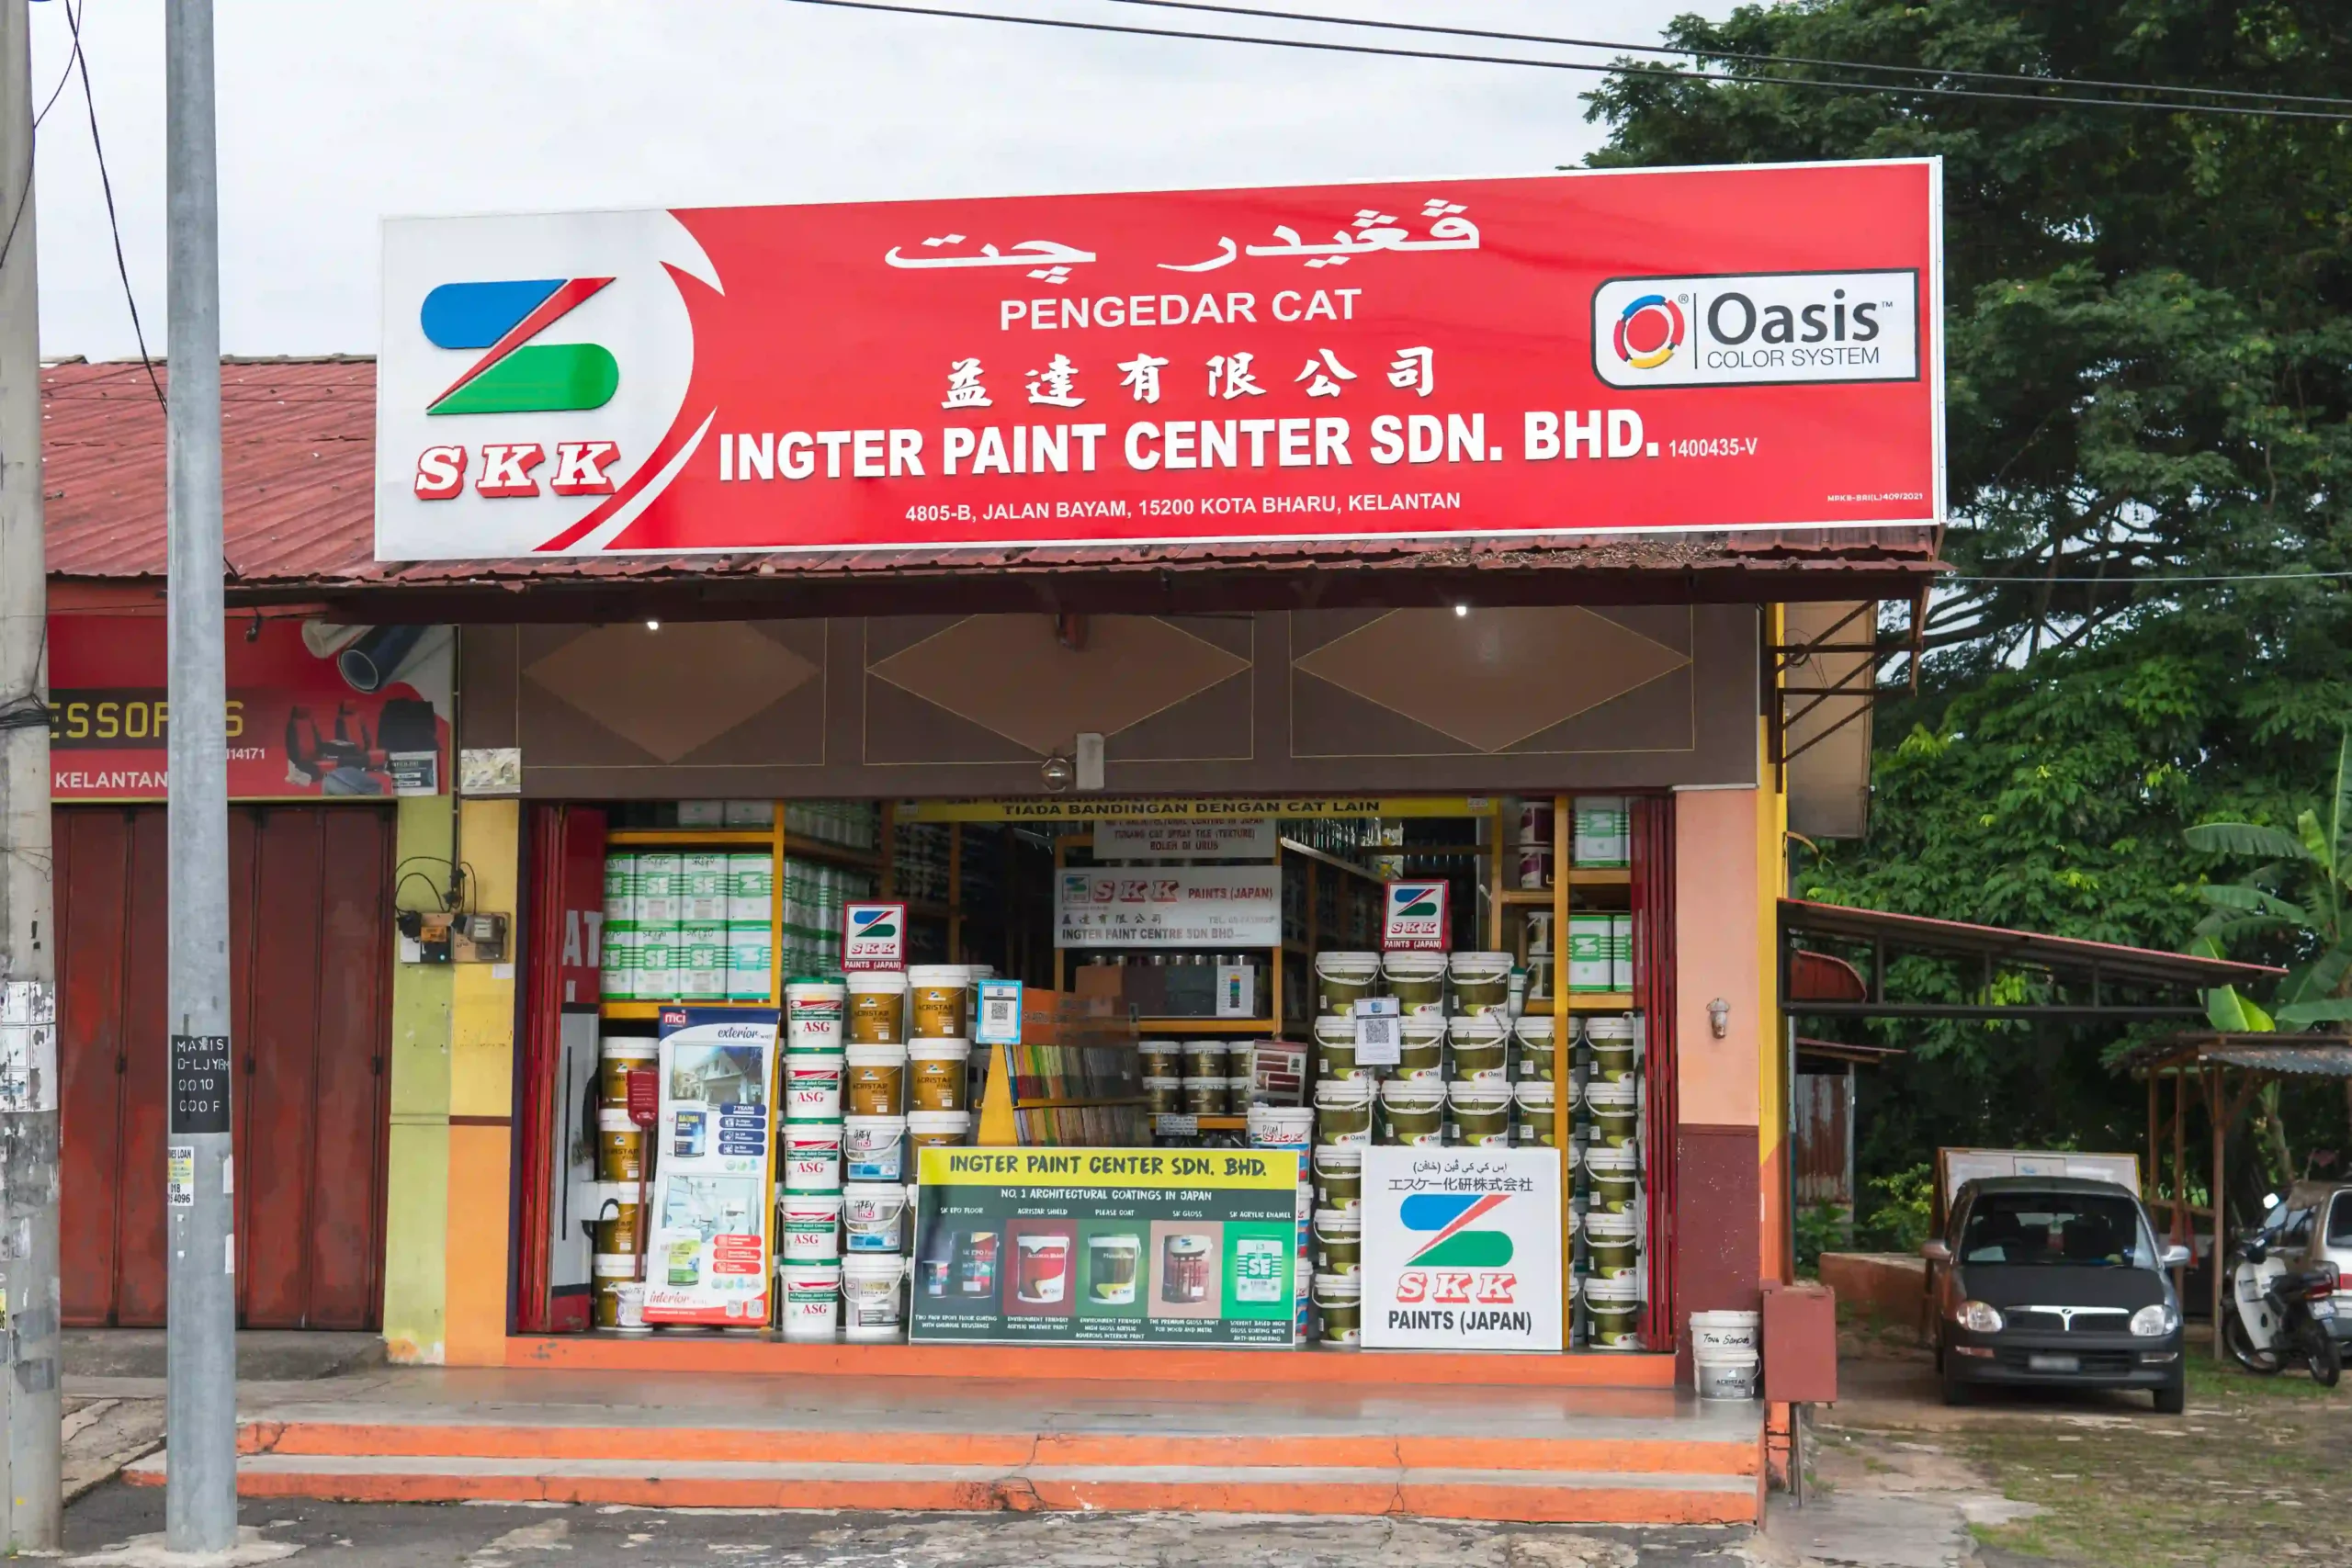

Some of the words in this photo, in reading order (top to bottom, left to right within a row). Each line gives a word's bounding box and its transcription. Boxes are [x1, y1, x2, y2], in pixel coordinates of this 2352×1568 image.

[1000, 293, 1256, 331] PENGEDAR
[1272, 288, 1363, 322] CAT
[1707, 288, 1881, 345] Oasis
[1707, 349, 1785, 369] COLOR
[1792, 347, 1880, 367] SYSTEM
[940, 345, 1435, 410] 益達有限公司
[719, 426, 927, 481] INGTER
[943, 423, 1107, 476] PAINT
[1124, 416, 1354, 471] CENTER
[1370, 412, 1502, 464] SDN.
[1524, 408, 1660, 461] BHD.
[1668, 436, 1758, 458] 1400435-V
[413, 441, 619, 501] SKK
[905, 504, 977, 525] 4805-B,
[982, 502, 1050, 521] JALAN
[1056, 500, 1133, 520] BAYAM,
[1138, 498, 1194, 517] 15200
[1201, 495, 1257, 514] KOTA
[1262, 494, 1342, 515] BHARU,
[1348, 491, 1462, 513] KELANTAN
[1002, 804, 1062, 816] TIADA
[1068, 803, 1189, 815] BANDINGAN
[1195, 802, 1281, 814] DENGAN
[1286, 802, 1326, 813] CAT
[1332, 801, 1380, 812] LAIN
[1092, 879, 1181, 903] SKK
[1188, 888, 1227, 899] PAINTS
[1230, 887, 1273, 900] (JAPAN)
[1062, 929, 1102, 940] INGTER
[1105, 929, 1136, 940] PAINT
[1139, 929, 1183, 940] CENTRE
[1389, 921, 1437, 934] SKK
[851, 942, 897, 954] SKK
[1384, 940, 1410, 949] PAINTS
[1413, 940, 1442, 950] (JAPAN)
[645, 950, 668, 967] SE
[690, 950, 715, 967] SE
[844, 961, 870, 969] PAINTS
[873, 961, 901, 970] (JAPAN)
[718, 1027, 759, 1039] exterior
[803, 1021, 831, 1032] ASG
[797, 1092, 824, 1103] ASG
[177, 1149, 191, 1158] LOAN
[797, 1162, 825, 1173] ASG
[950, 1156, 1018, 1173] INGTER
[1027, 1156, 1081, 1174] PAINT
[1089, 1156, 1164, 1175] CENTER
[1171, 1158, 1216, 1176] SDN.
[1224, 1159, 1267, 1177] BHD.
[1387, 1177, 1533, 1192] エスケー化研株式会社
[1030, 1189, 1108, 1199] ARCHITECTURAL
[1112, 1190, 1161, 1201] COATINGS
[1165, 1191, 1176, 1201] IN
[1181, 1191, 1212, 1201] JAPAN
[794, 1234, 820, 1245] ASG
[1248, 1258, 1272, 1276] SE
[1396, 1272, 1517, 1304] SKK
[650, 1292, 689, 1304] interior
[802, 1304, 828, 1314] ASG
[1388, 1310, 1454, 1330] PAINTS
[1460, 1310, 1532, 1336] (JAPAN)
